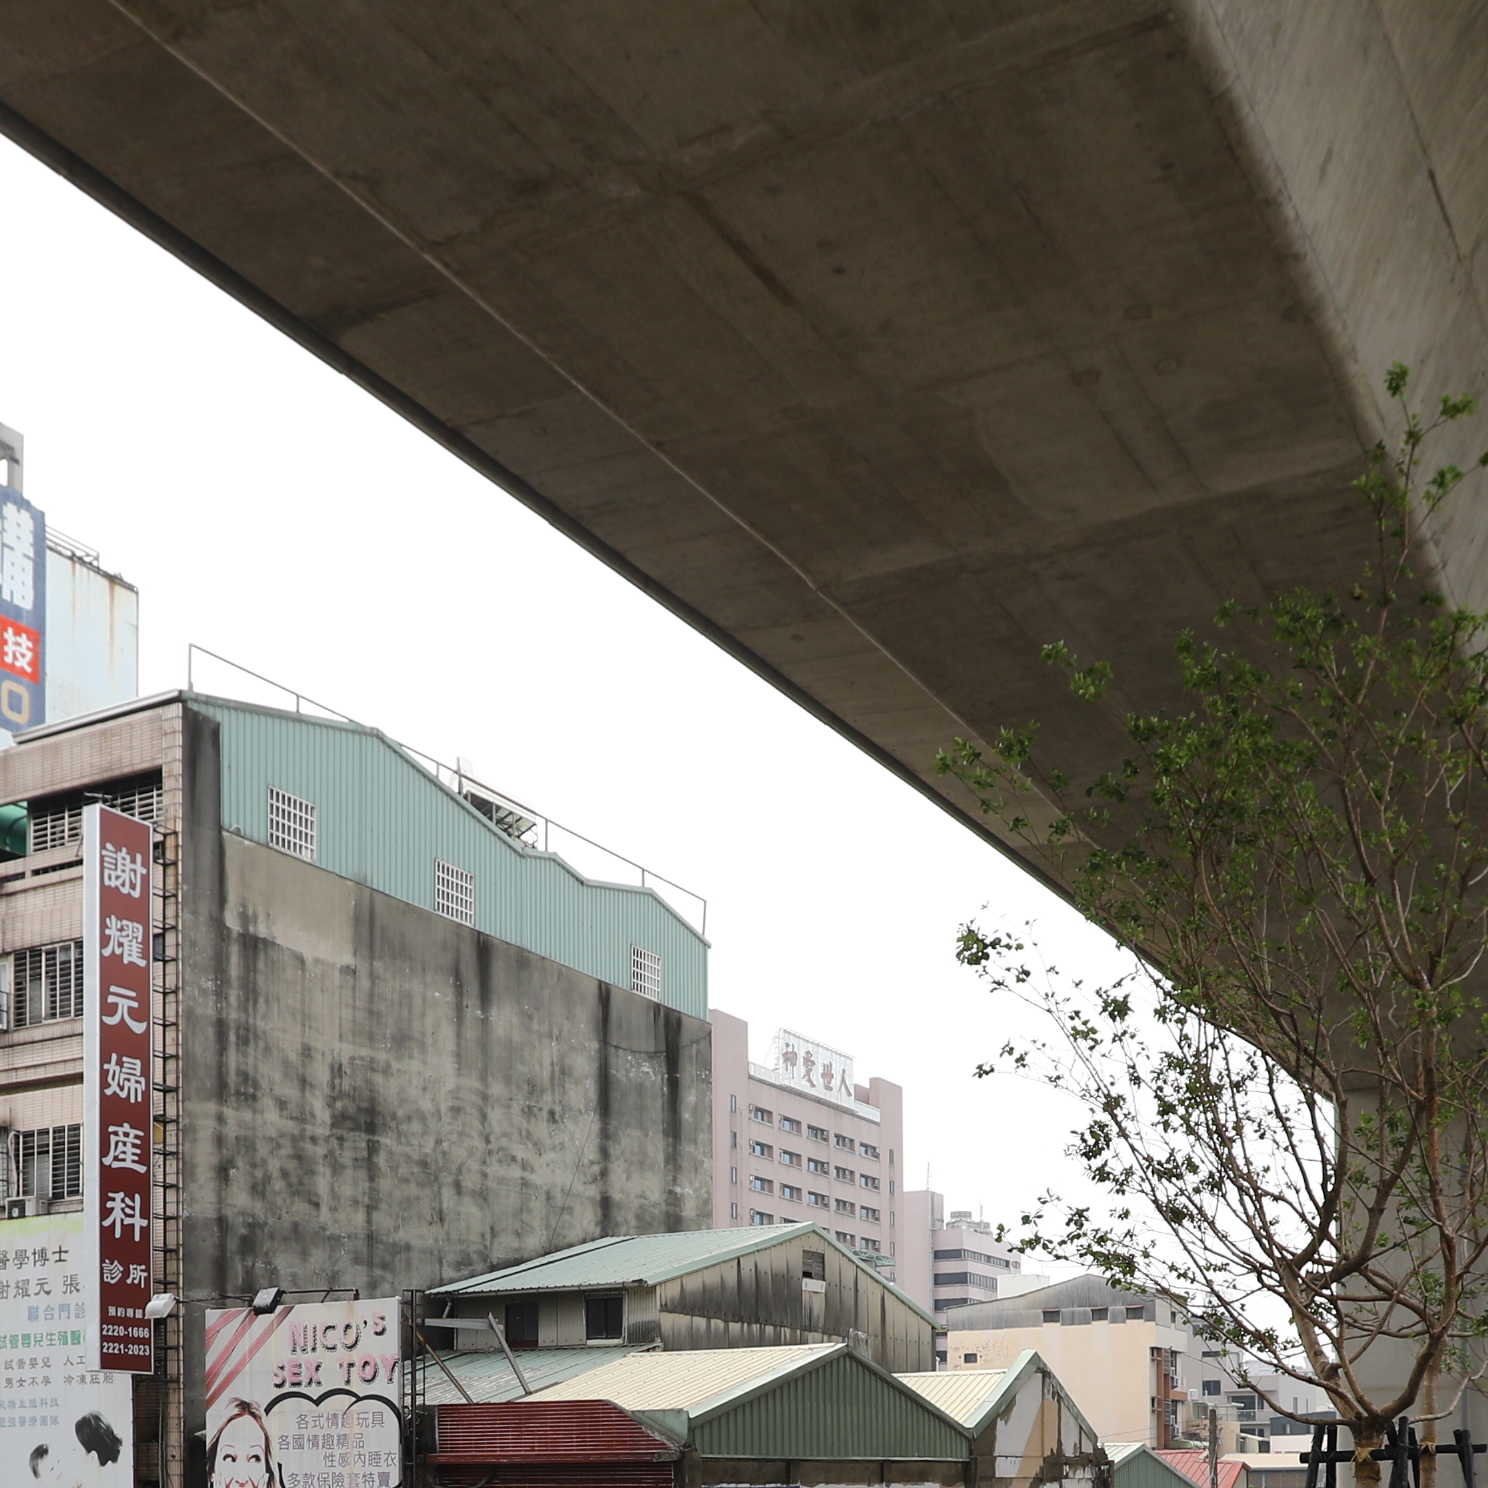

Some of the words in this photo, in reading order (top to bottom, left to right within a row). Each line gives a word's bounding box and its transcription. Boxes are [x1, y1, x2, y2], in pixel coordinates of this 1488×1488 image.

[781, 1041, 853, 1098] 神愛世人
[101, 1259, 149, 1288] 診所
[27, 1302, 85, 1322] 聯合門診
[107, 1306, 144, 1318] 預約專線
[101, 1324, 150, 1339] 2220-1666
[288, 1310, 387, 1355] NICO'S
[102, 1342, 150, 1356] 2221-2023
[3, 1356, 52, 1371] 試管嬰兒
[271, 1357, 323, 1389] SEX
[337, 1352, 400, 1386] TOY
[3, 1376, 52, 1389] 男女不孕
[63, 1373, 114, 1386] 冷凍胚胎
[295, 1411, 386, 1430] 各式情趣玩具
[277, 1433, 366, 1451] 各國情趣精品
